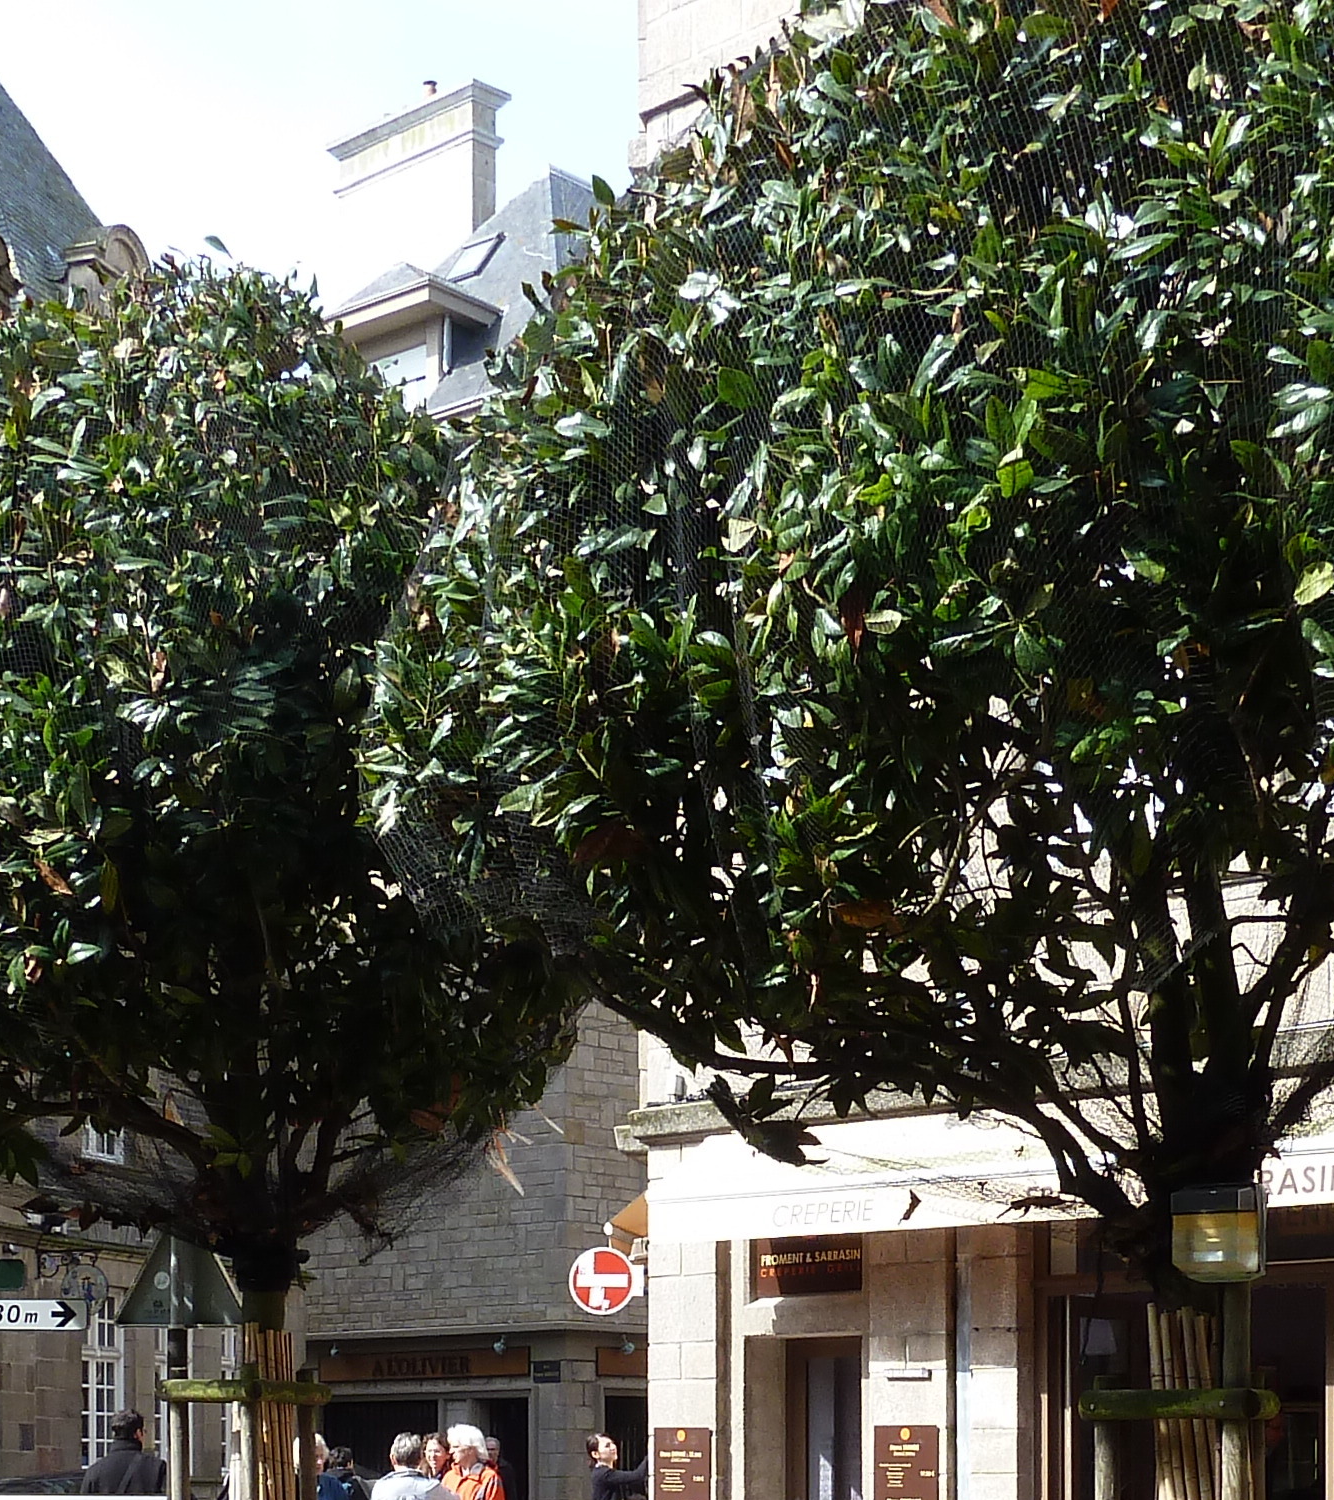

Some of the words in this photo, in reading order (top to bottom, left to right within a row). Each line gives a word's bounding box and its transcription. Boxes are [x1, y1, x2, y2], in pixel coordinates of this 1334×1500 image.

[772, 1199, 875, 1228] CREPERIE
[760, 1253, 803, 1267] FROMENT
[806, 1253, 812, 1263] &
[814, 1248, 861, 1262] SARRASIN
